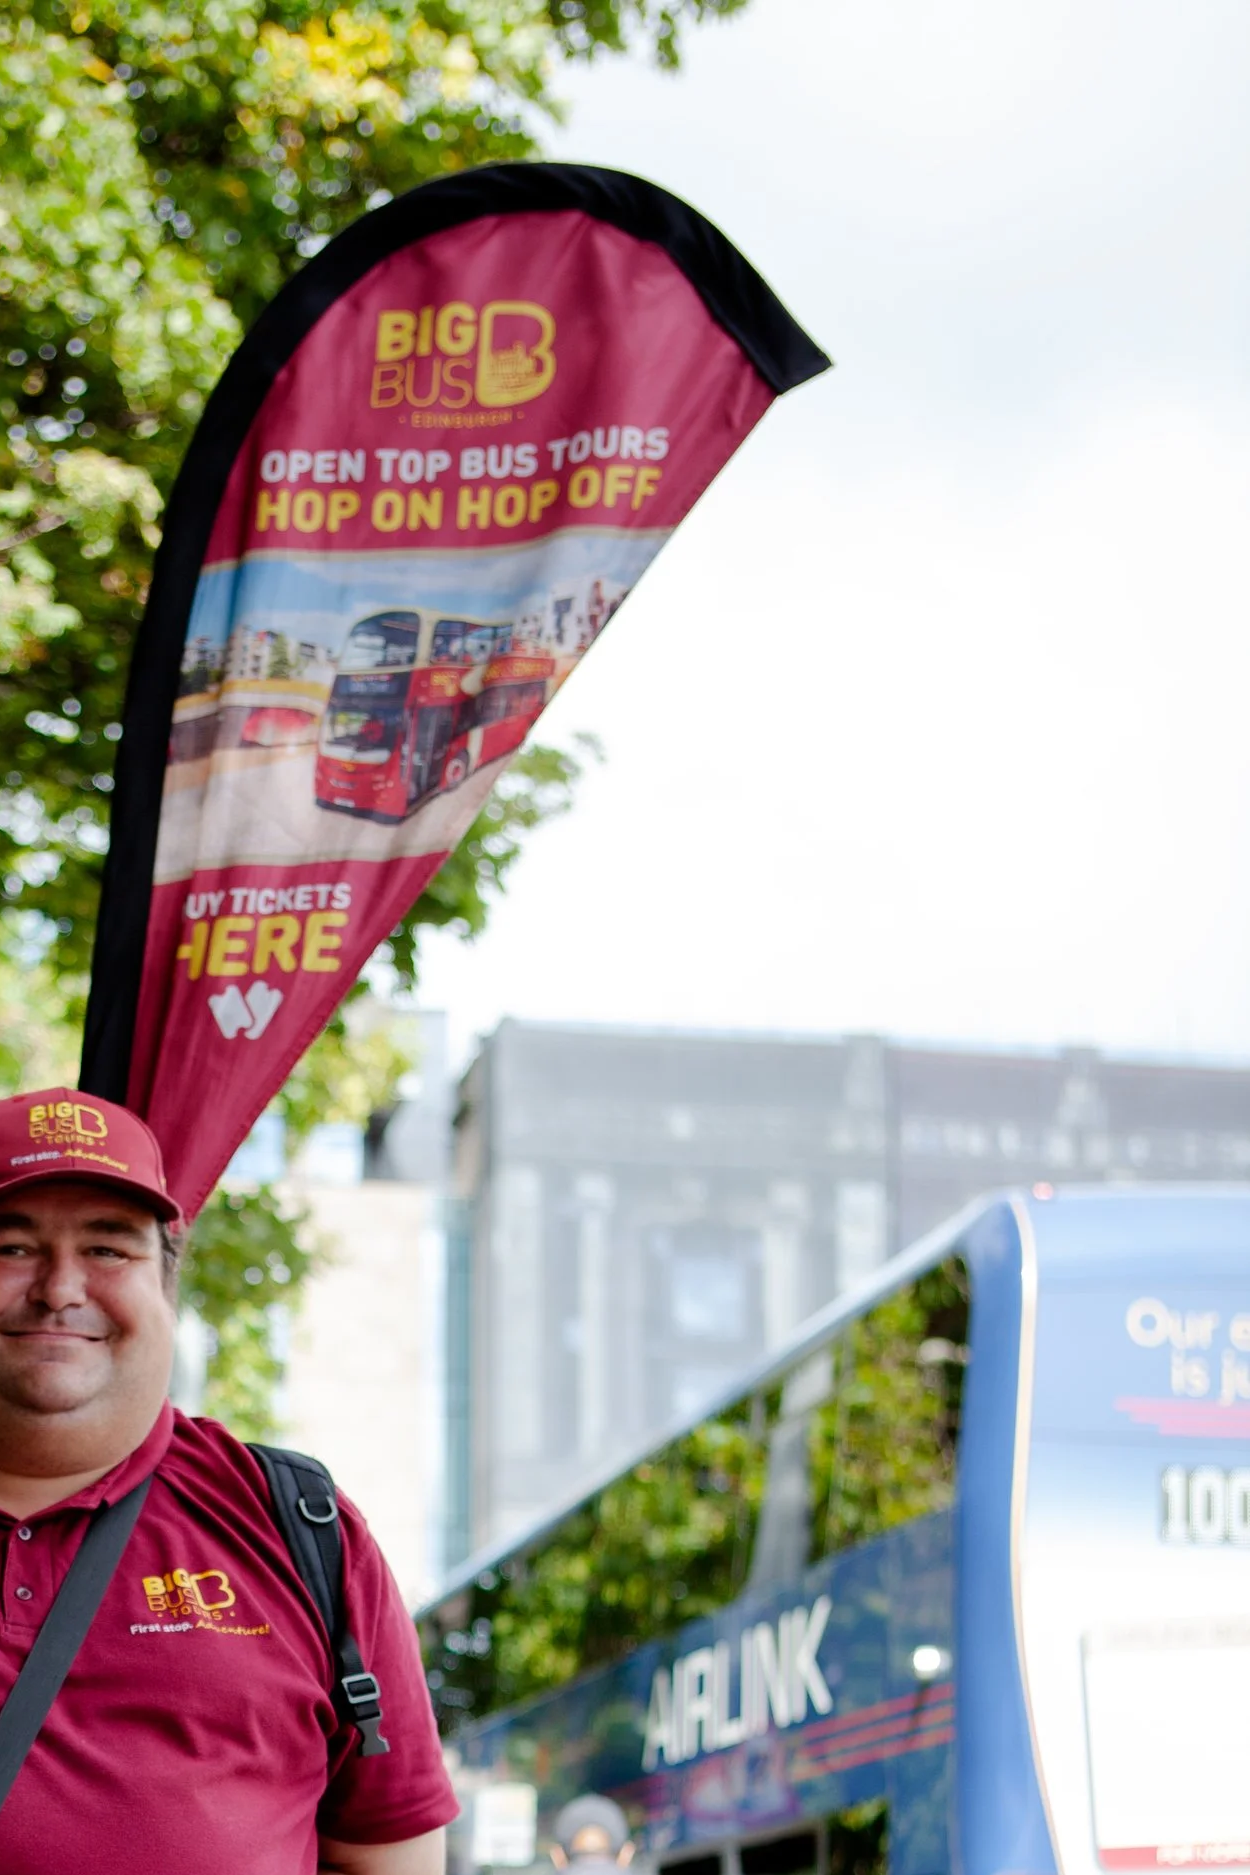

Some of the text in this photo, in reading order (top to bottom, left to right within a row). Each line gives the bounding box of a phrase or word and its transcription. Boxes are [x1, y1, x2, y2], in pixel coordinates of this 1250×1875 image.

[376, 302, 478, 362] BIG
[370, 357, 475, 408] BUS
[260, 425, 670, 484] OPEN TOP BUS TOURS
[254, 463, 664, 533] HOP ON HOP OFF
[185, 882, 352, 919] UY TICKETS
[29, 1118, 74, 1138] BUS
[30, 1102, 73, 1121] BIG
[46, 1135, 95, 1145] TOURS
[1125, 1296, 1221, 1351] Our
[1170, 1347, 1211, 1398] is
[142, 1568, 190, 1595] BIG
[146, 1587, 199, 1612] BUS
[130, 1623, 161, 1635] First
[163, 1622, 193, 1633] stop.
[171, 1605, 223, 1620] TOURS
[641, 1594, 833, 1774] AIRLINK
